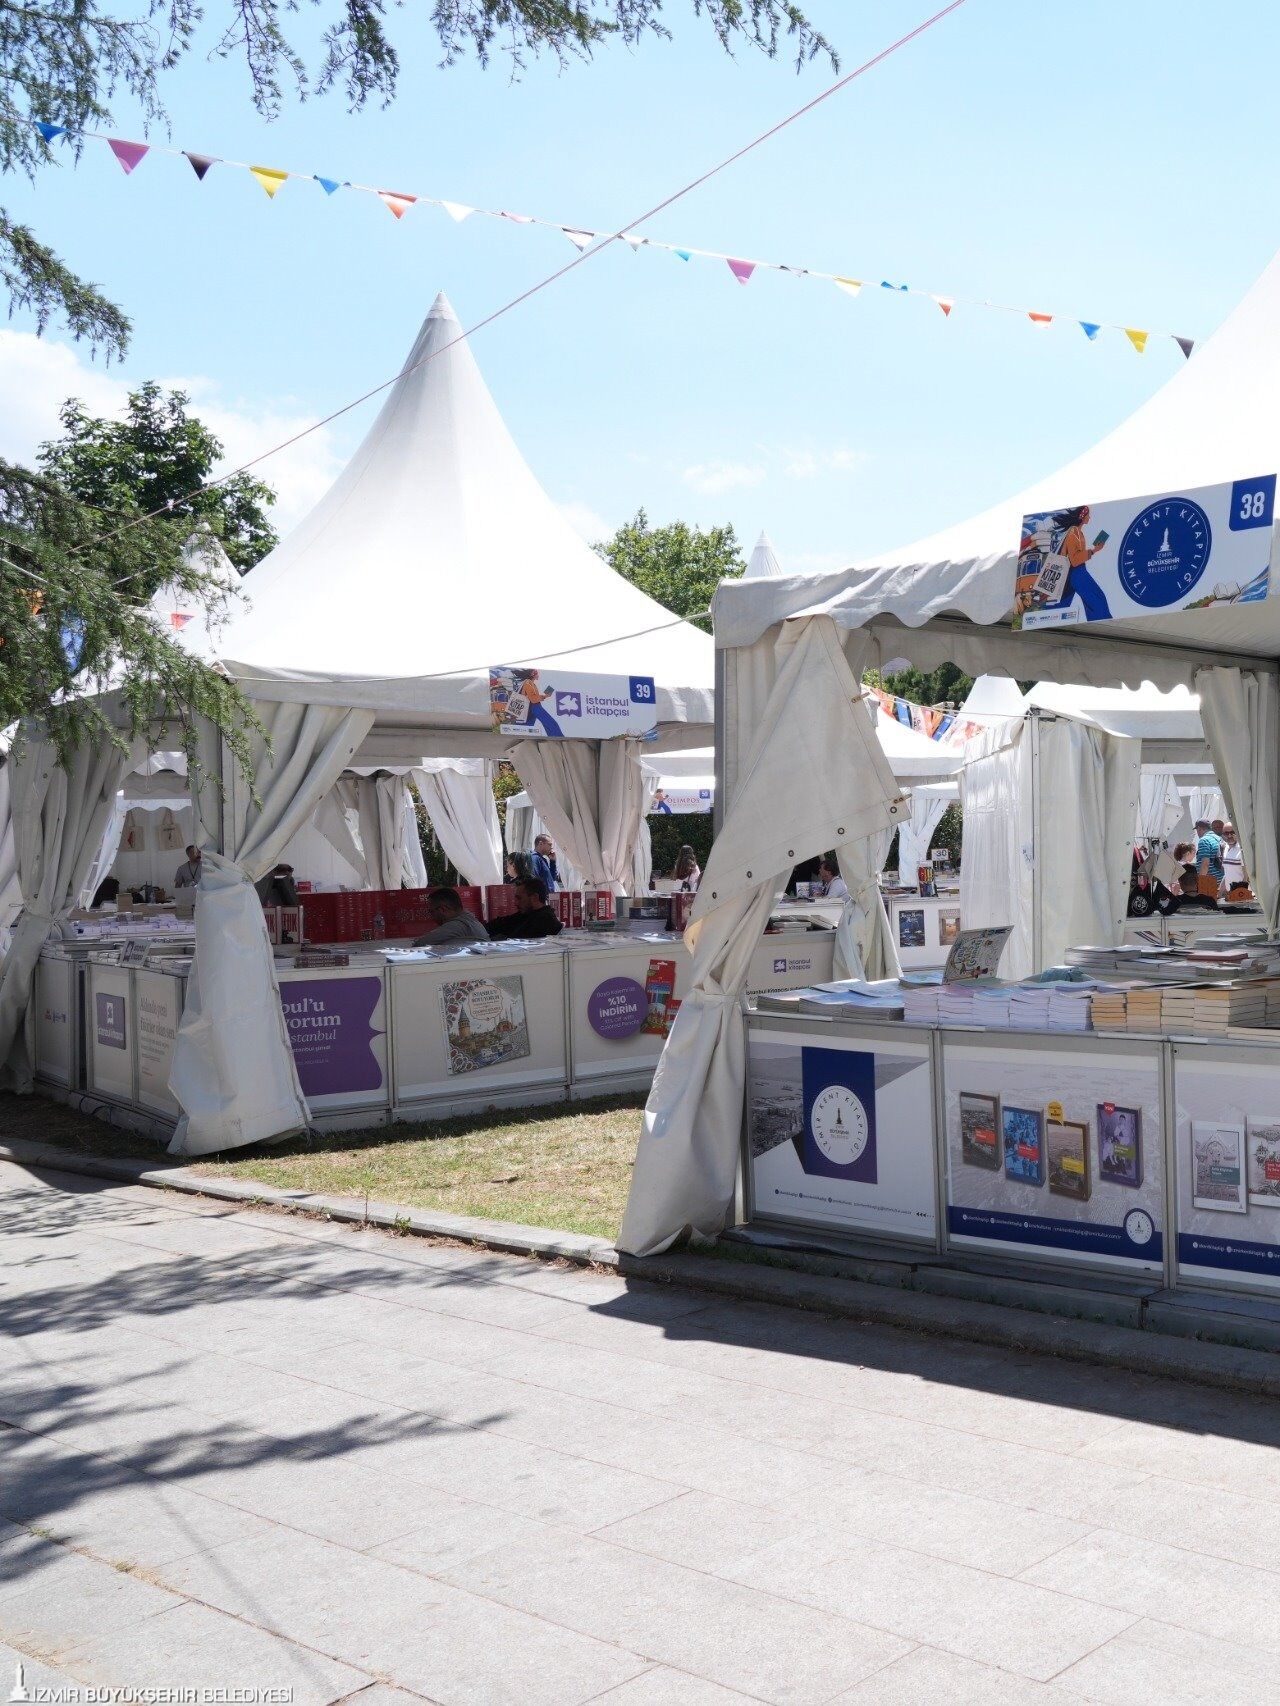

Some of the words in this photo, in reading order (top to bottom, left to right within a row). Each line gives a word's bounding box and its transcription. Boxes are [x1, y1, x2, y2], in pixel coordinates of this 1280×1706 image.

[1240, 491, 1265, 520] 38
[1134, 507, 1170, 537] KENT
[1177, 508, 1204, 589] KİTAPLIĞI
[1124, 549, 1147, 595] İZMİR
[636, 683, 651, 699] 39
[586, 695, 629, 707] istanbul
[586, 706, 630, 718] kitapçısı
[607, 995, 627, 1006] %10
[599, 1003, 638, 1018] İNDİRİM
[291, 1029, 337, 1043] stanbul
[818, 1092, 839, 1110] KENT
